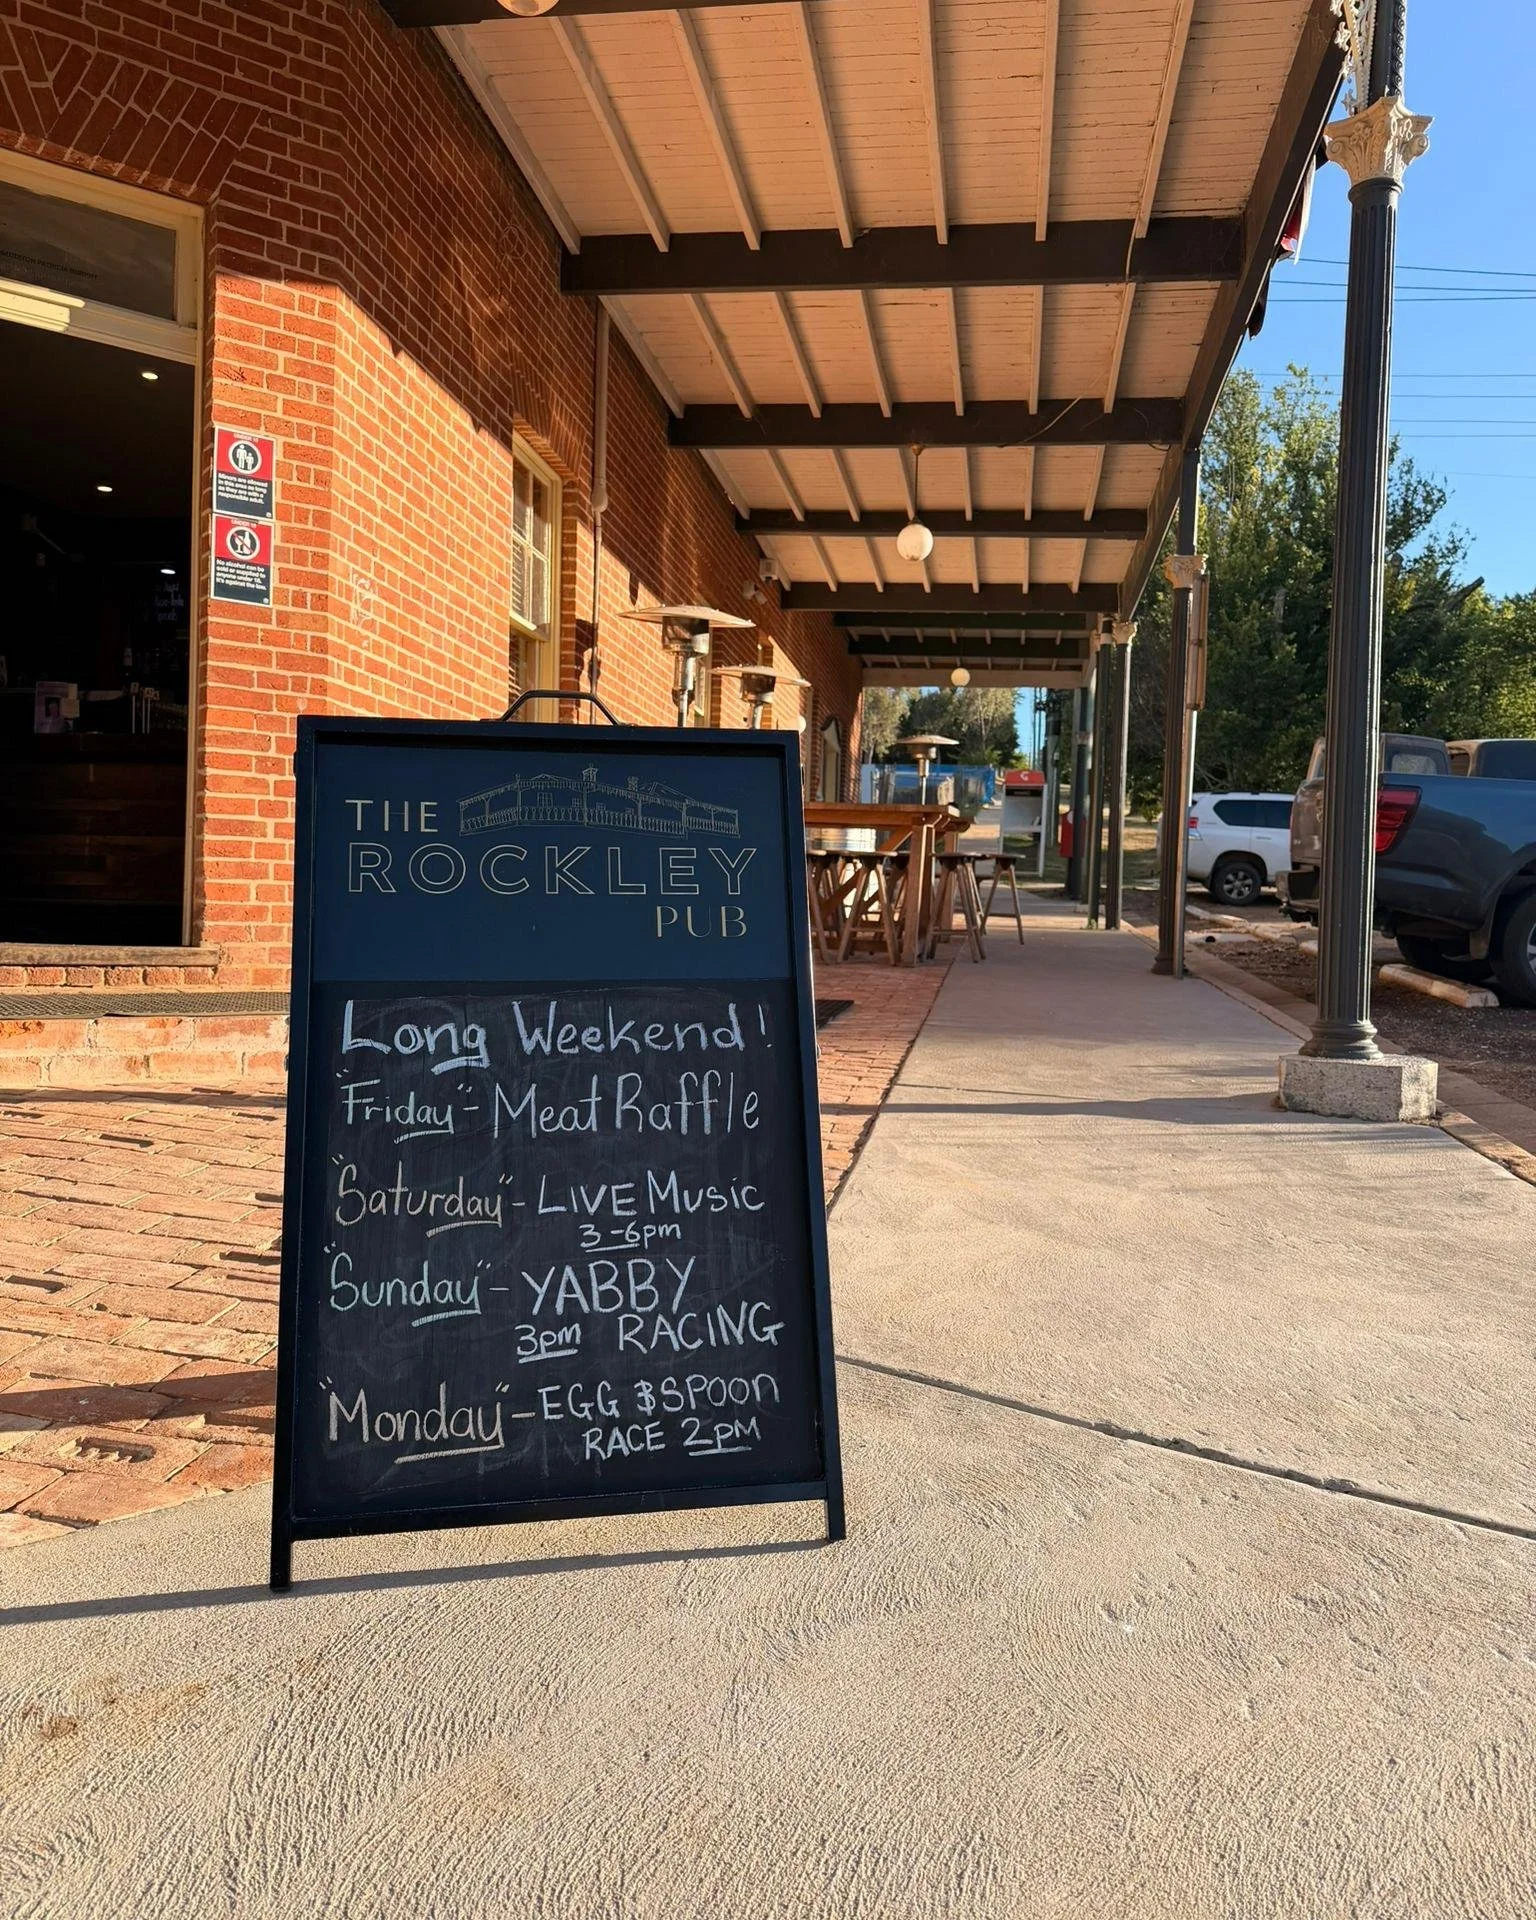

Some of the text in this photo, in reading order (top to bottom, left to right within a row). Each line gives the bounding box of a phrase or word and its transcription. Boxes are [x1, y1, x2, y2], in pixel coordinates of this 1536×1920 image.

[217, 491, 249, 501] responsible
[218, 473, 237, 481] Minors
[247, 479, 268, 488] allowed
[226, 486, 238, 494] they
[254, 486, 267, 494] long
[216, 572, 237, 580] anyone
[236, 575, 254, 583] under
[225, 561, 246, 569] alcohol
[235, 569, 260, 578] supplied
[225, 579, 246, 588] against
[345, 799, 439, 834] THE
[348, 842, 758, 896] ROCKLEY
[655, 904, 748, 939] PUB
[342, 1000, 491, 1073] Long
[493, 1074, 602, 1138] Meat
[615, 1070, 760, 1135] Raffle
[646, 1169, 766, 1215] Music
[521, 1256, 696, 1315] YABBY
[515, 1301, 786, 1358] 3pm RACING
[537, 1381, 621, 1421] EGG
[582, 1421, 666, 1461] RACE
